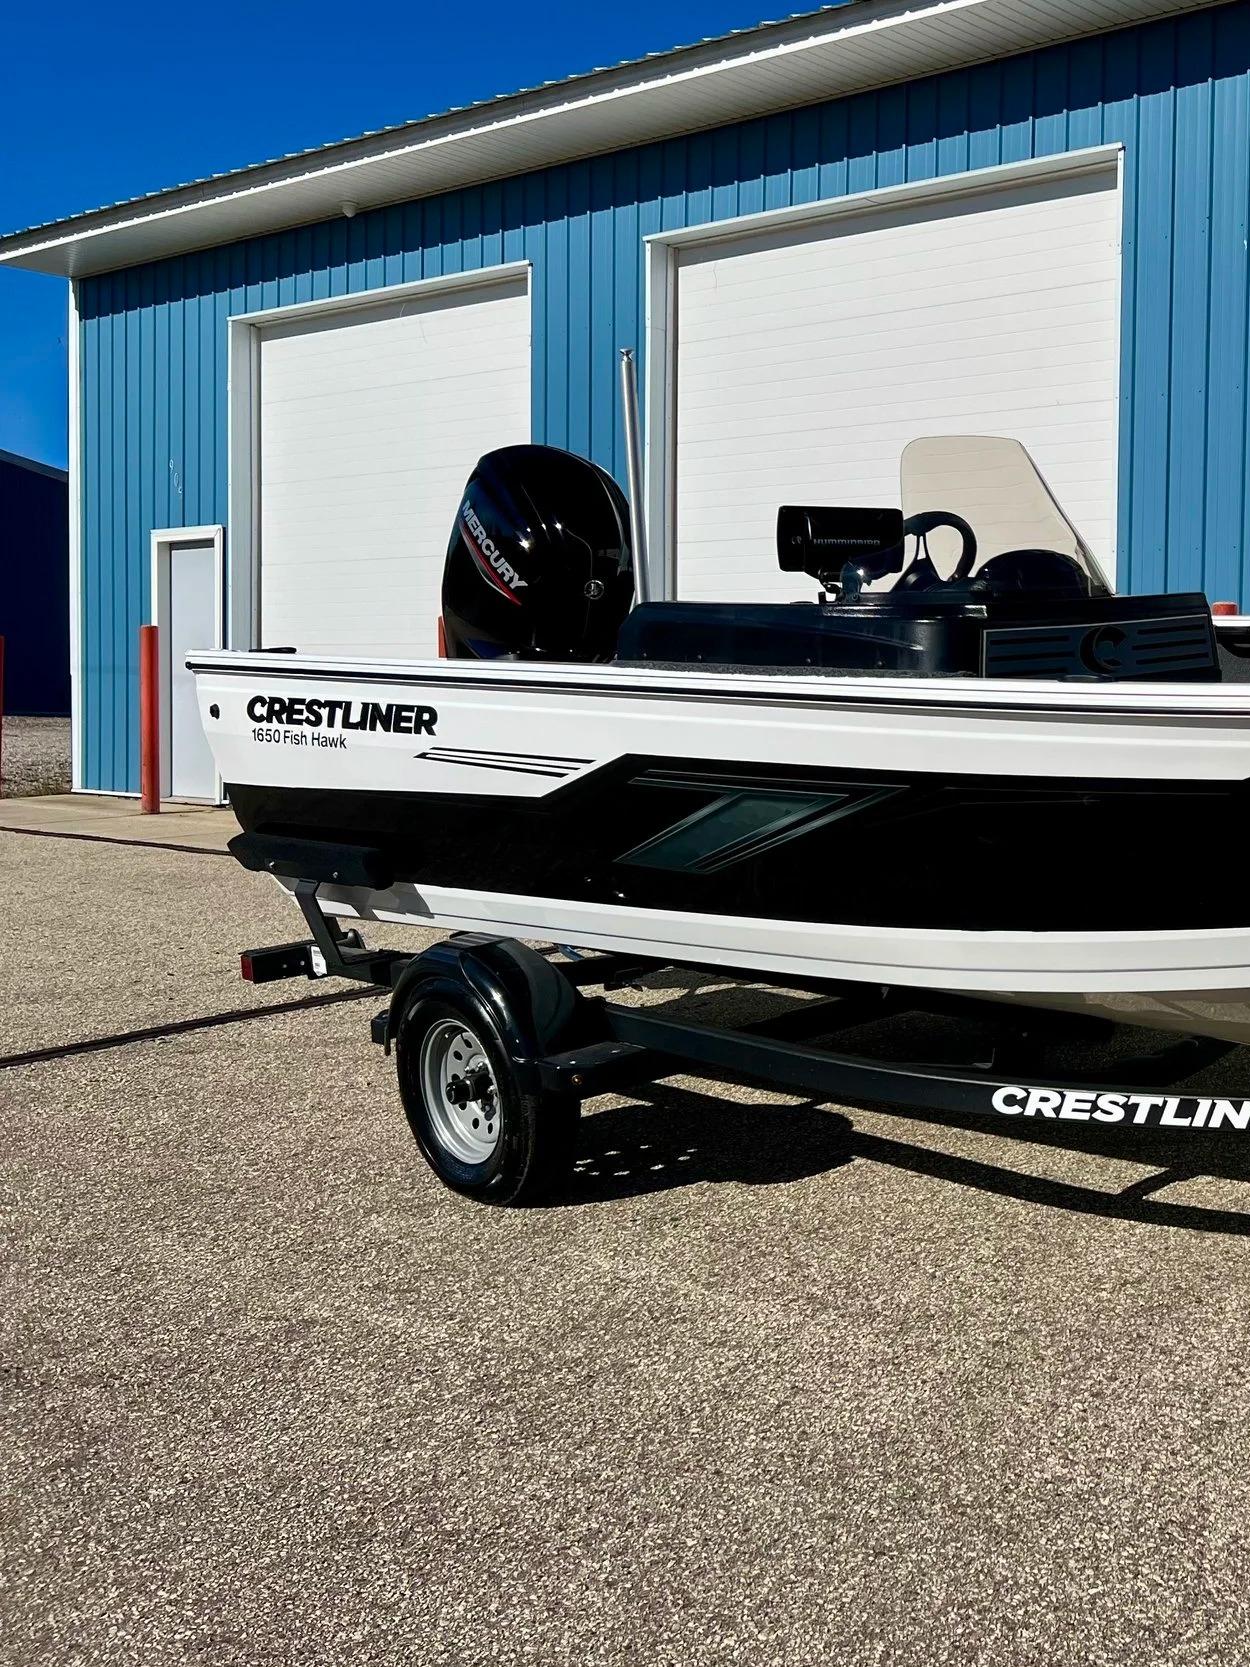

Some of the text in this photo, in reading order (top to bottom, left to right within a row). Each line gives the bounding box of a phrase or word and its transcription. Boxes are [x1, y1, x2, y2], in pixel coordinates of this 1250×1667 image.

[462, 500, 528, 590] MERCURY
[247, 695, 438, 736] CRESTLINER
[251, 727, 347, 749] 1650 Fish Hawk
